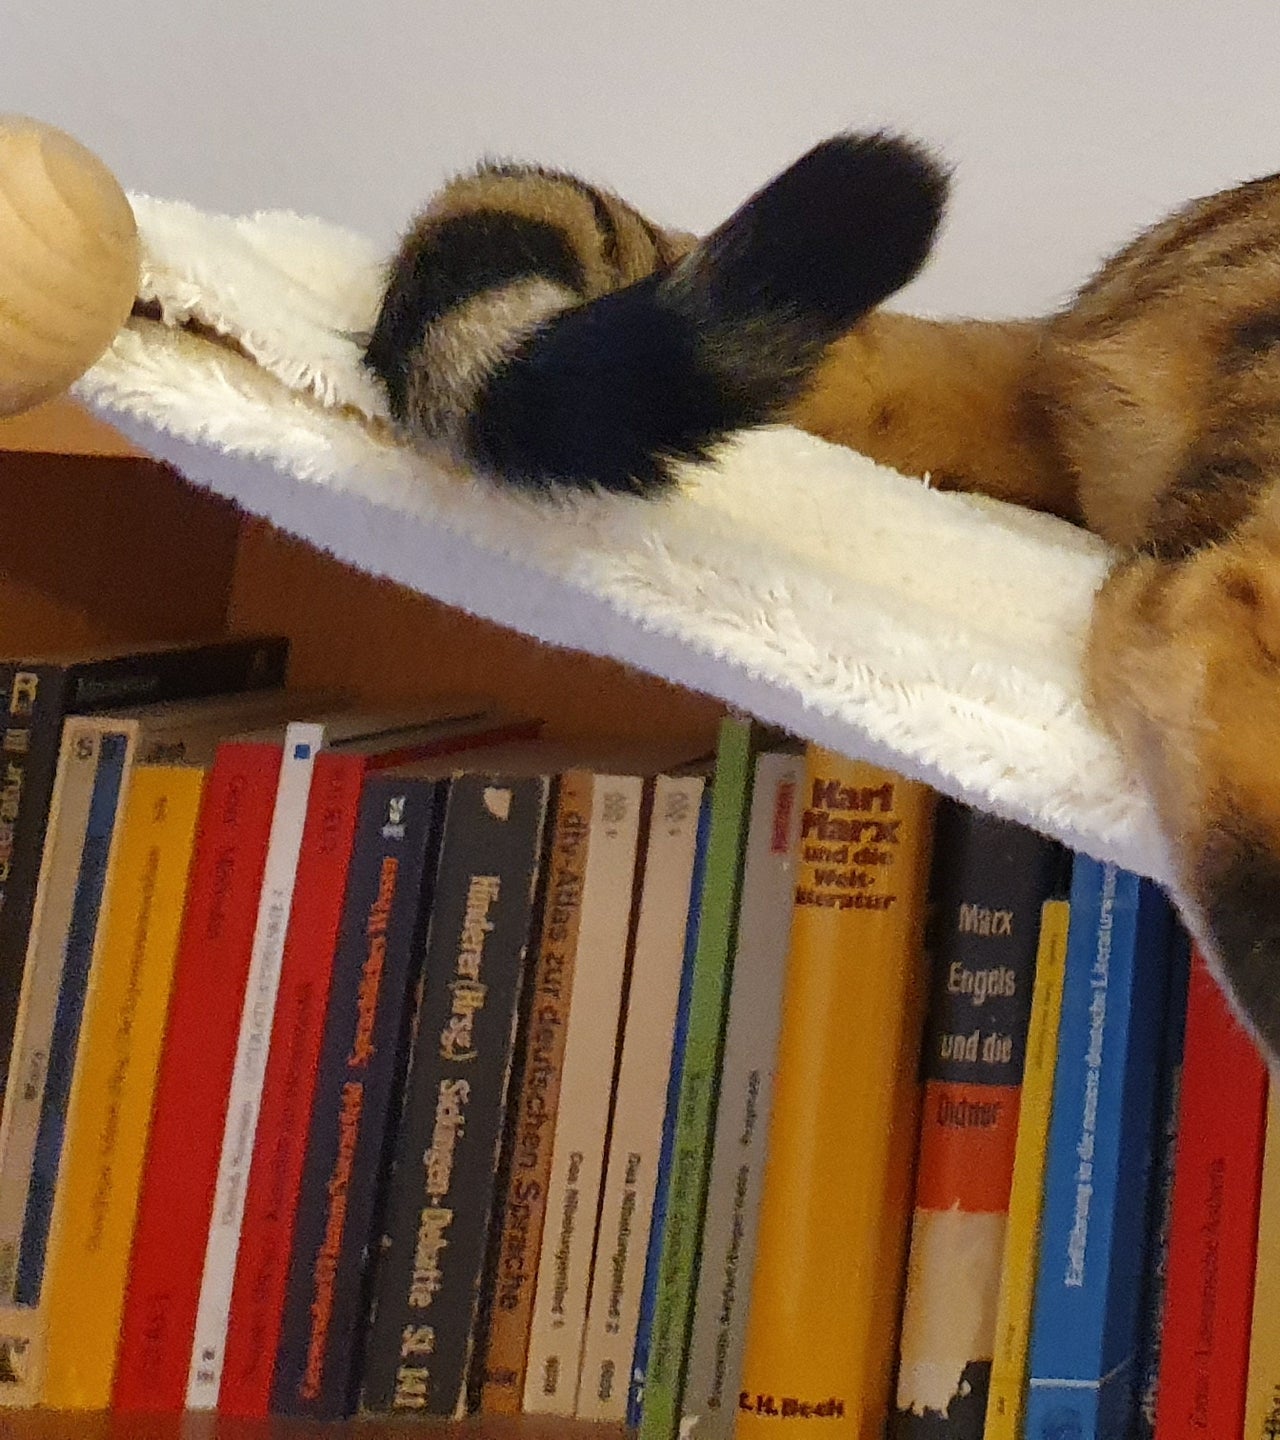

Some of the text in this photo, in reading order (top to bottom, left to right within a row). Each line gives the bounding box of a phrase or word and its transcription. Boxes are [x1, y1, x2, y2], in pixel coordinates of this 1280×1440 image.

[812, 778, 895, 812] Karl
[801, 810, 901, 843] Marx
[804, 845, 894, 865] und die
[959, 902, 1014, 937] Marx
[947, 961, 1016, 1006] Engels
[497, 812, 590, 1309] dtv-Atlas zur deutschen Sprache
[940, 1030, 1013, 1063] und die
